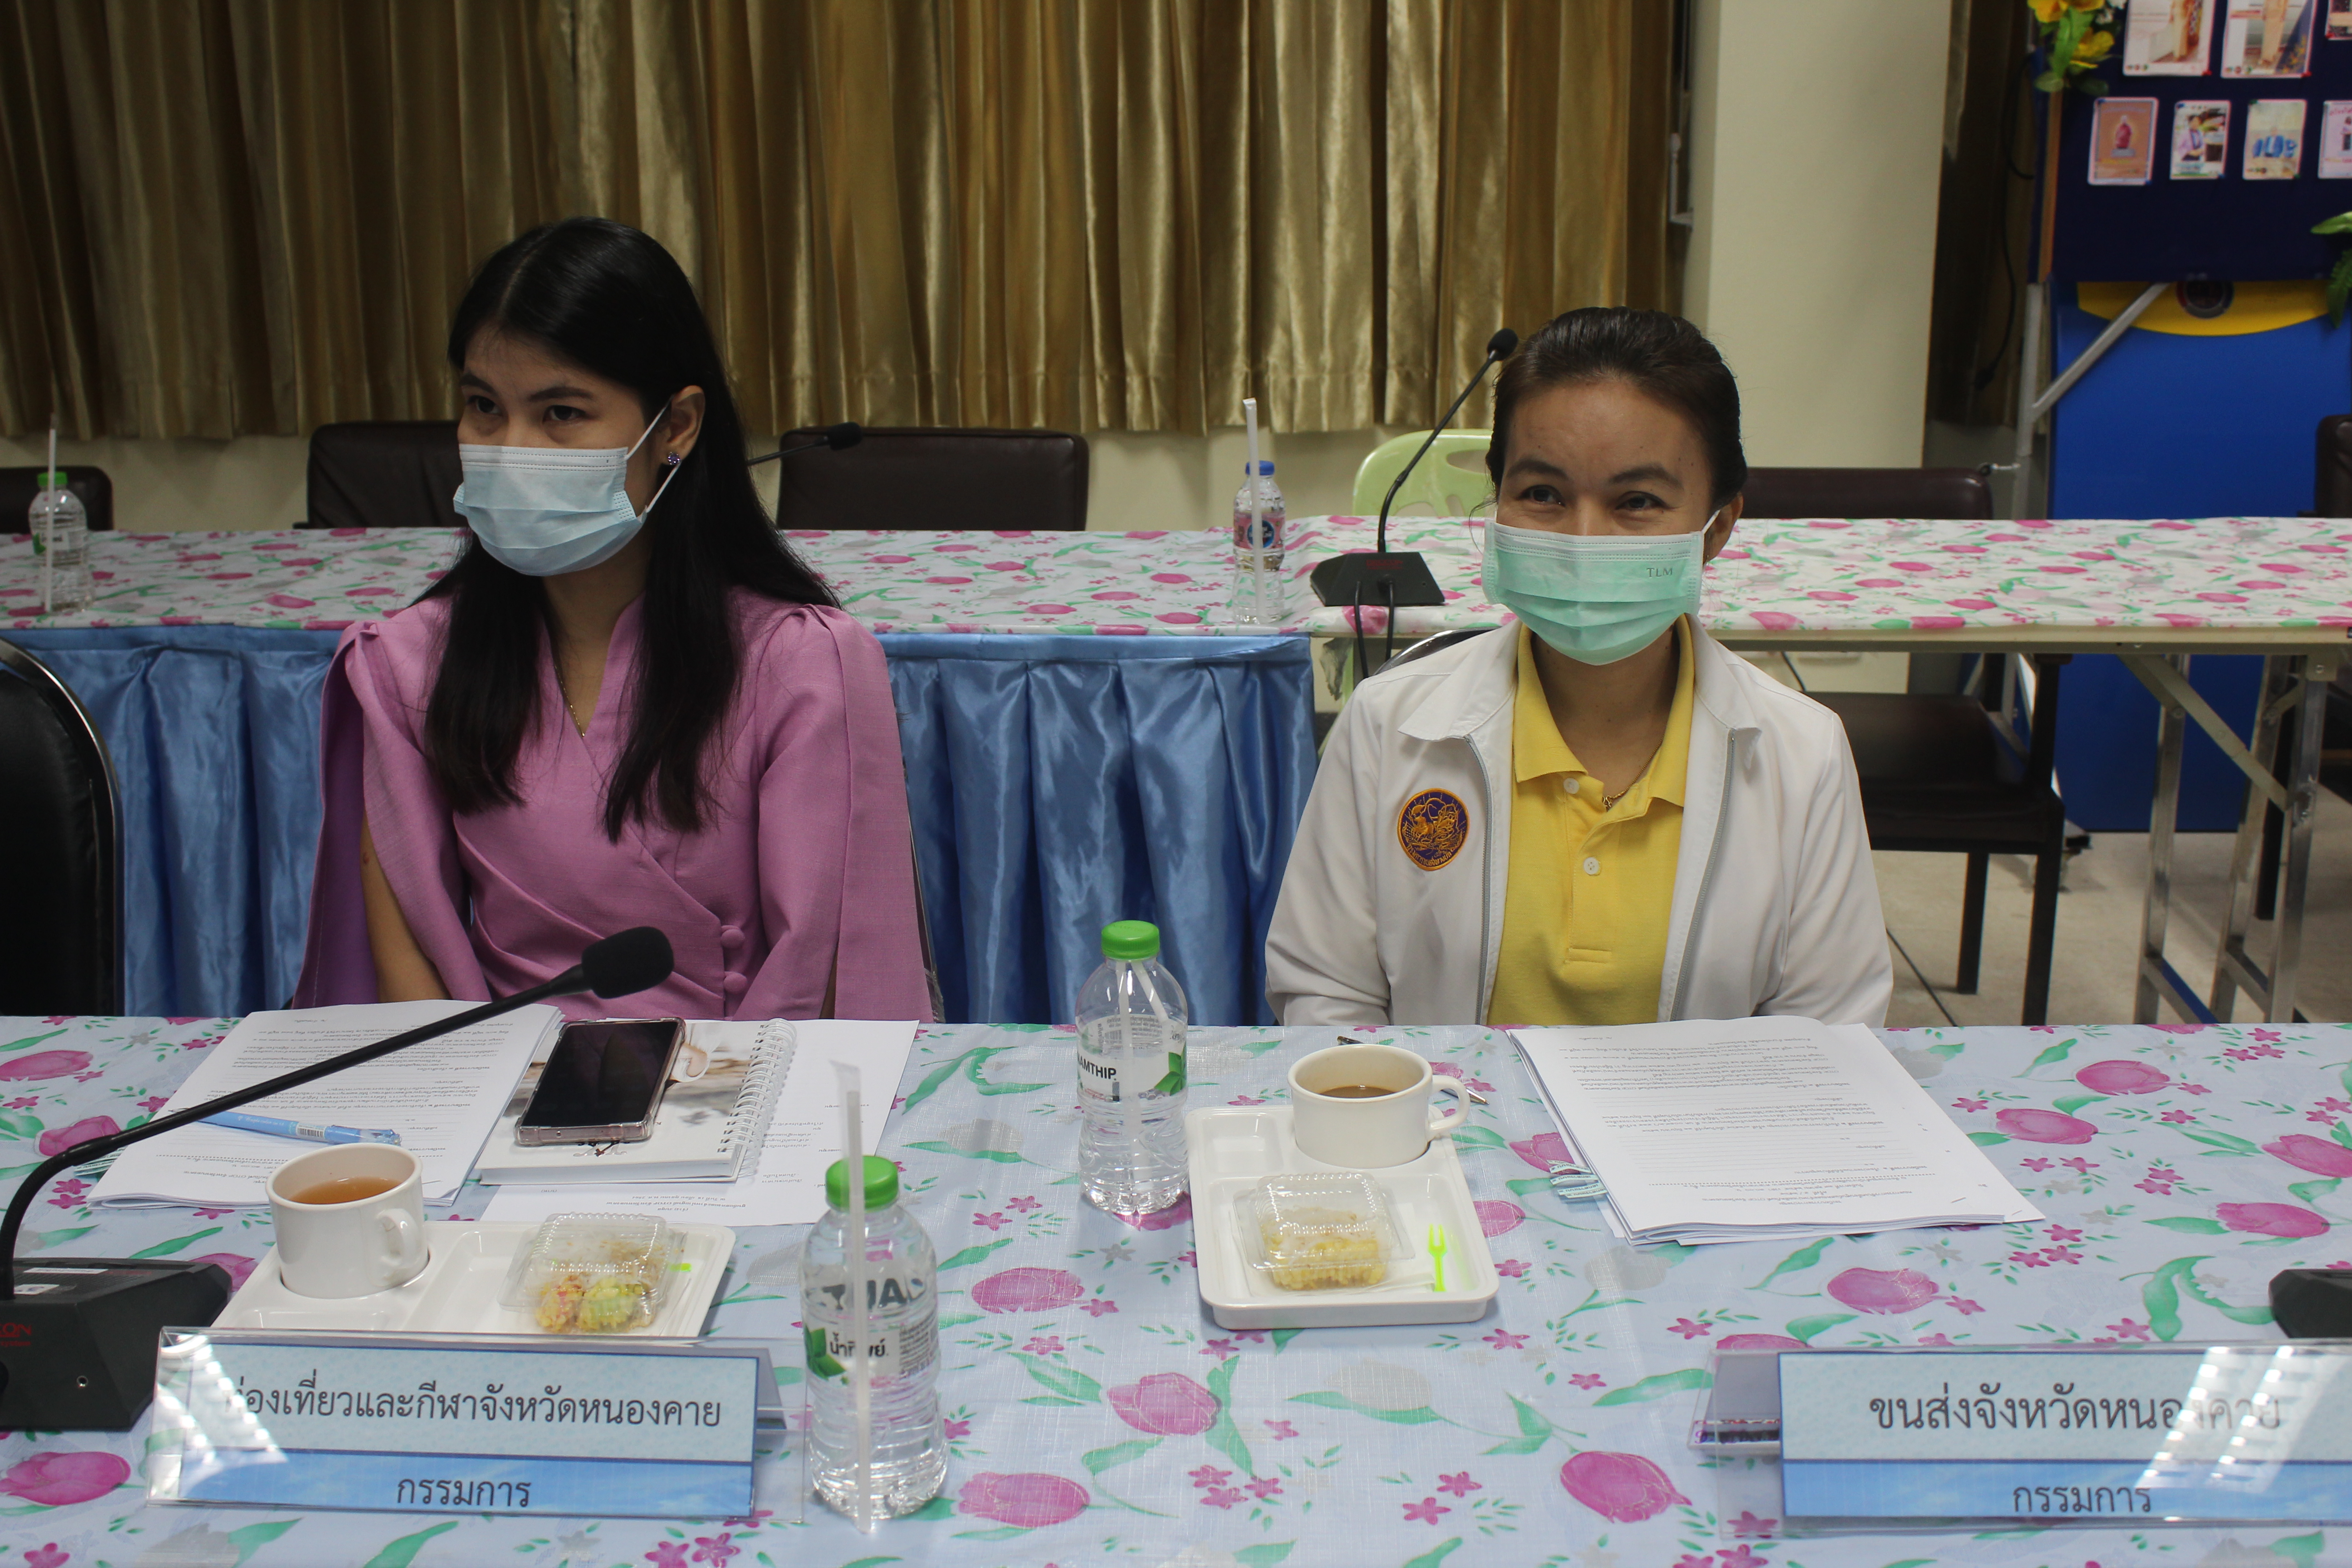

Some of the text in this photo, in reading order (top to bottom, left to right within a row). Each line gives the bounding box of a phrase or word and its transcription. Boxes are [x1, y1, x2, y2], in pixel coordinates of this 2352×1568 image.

[1646, 568, 1673, 577] TLM
[224, 1368, 722, 1427] ่องเที่ยวและกีฬาจังหวัดหนองคาย
[396, 1474, 532, 1509] กรรมการ
[2012, 1485, 2153, 1514] กรรมการ
